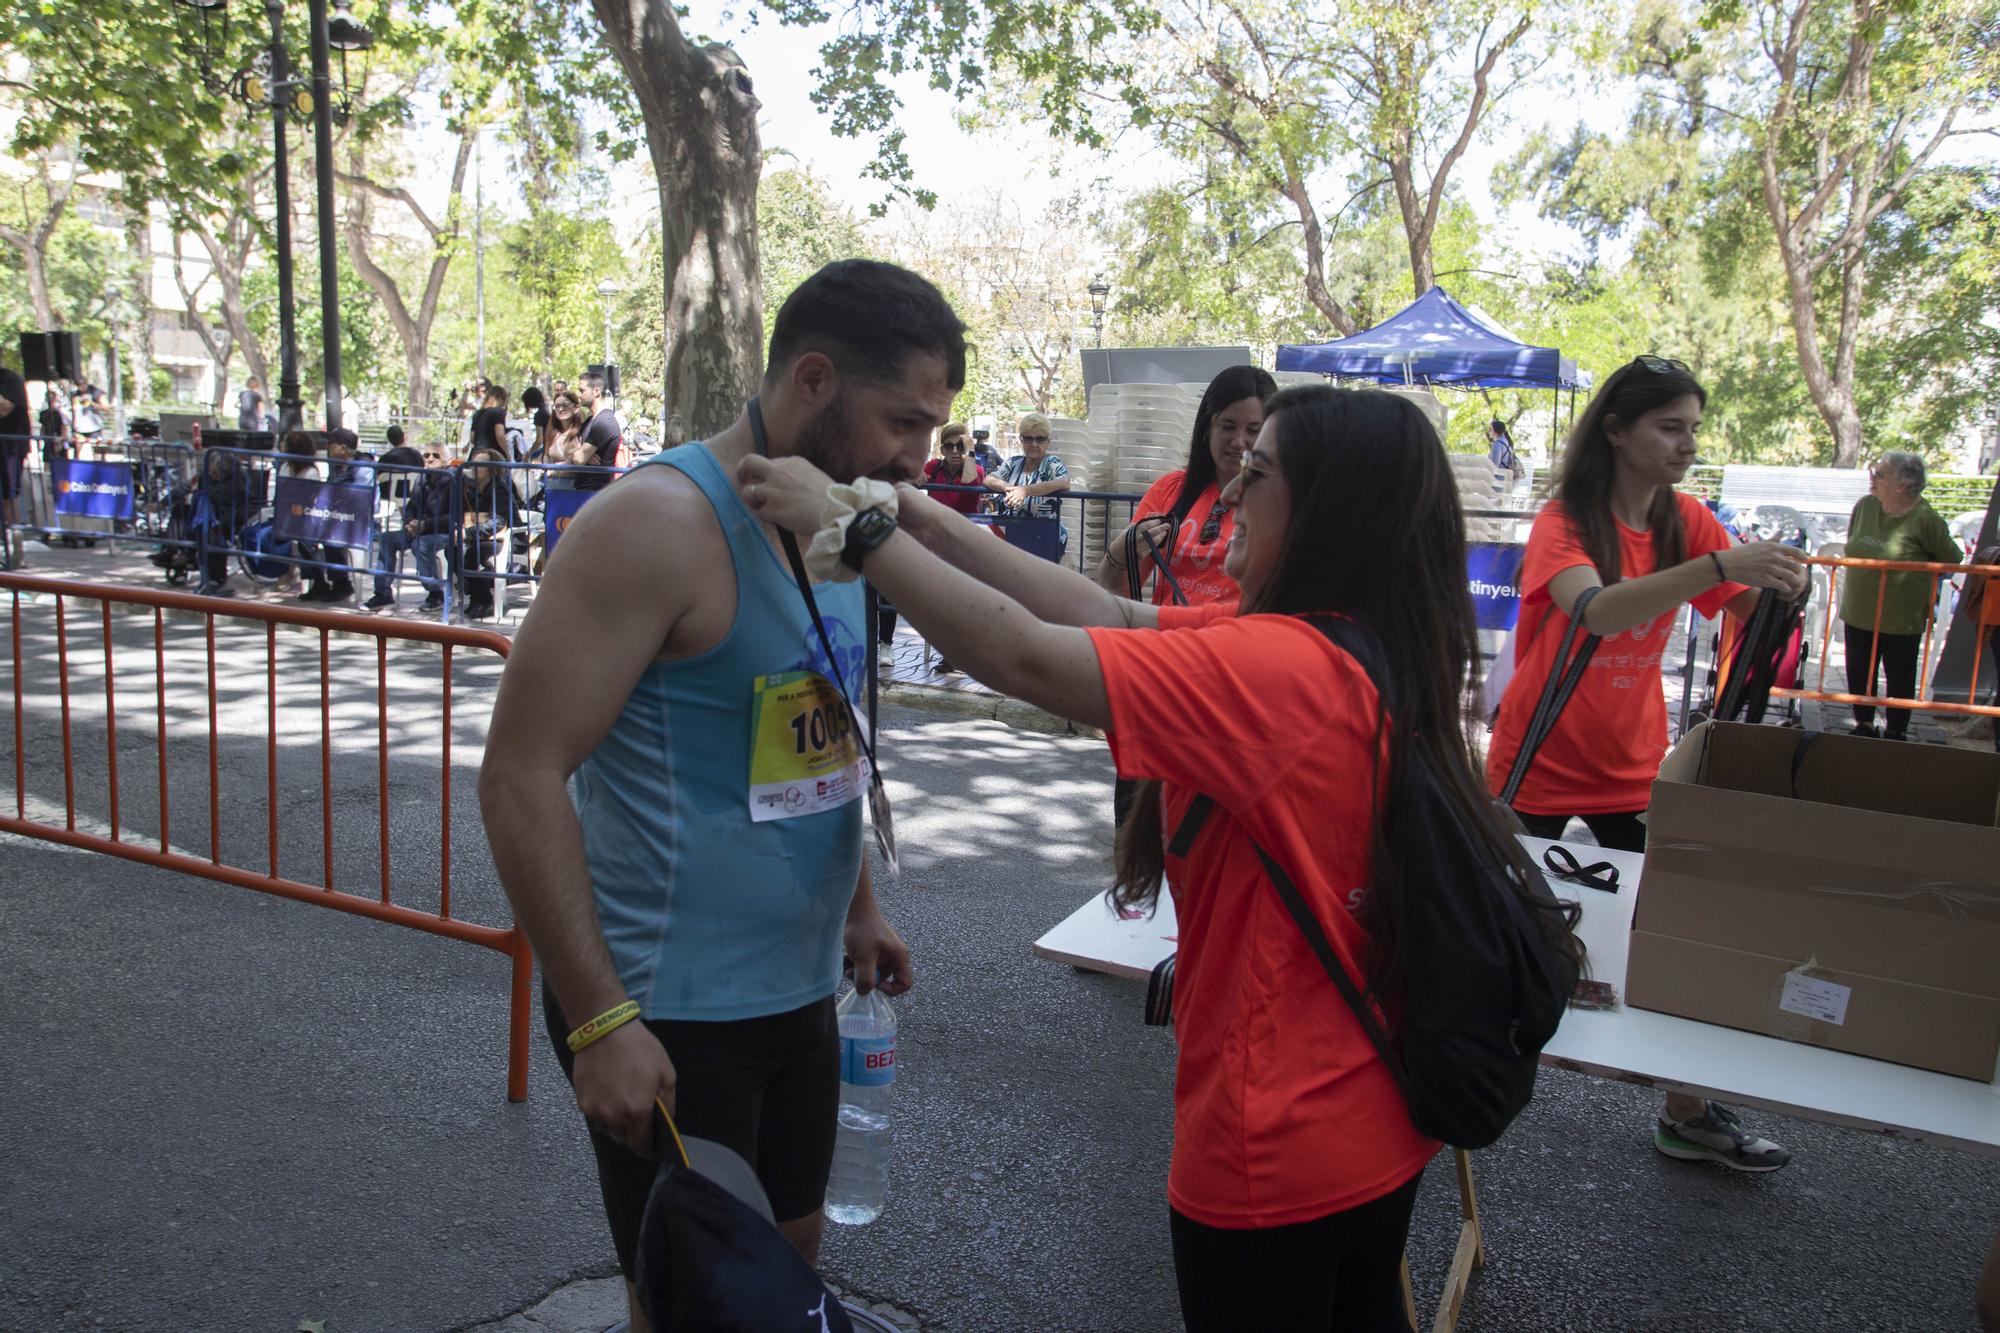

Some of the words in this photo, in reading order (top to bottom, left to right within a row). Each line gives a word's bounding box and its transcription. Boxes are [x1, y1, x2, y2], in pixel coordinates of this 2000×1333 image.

[70, 480, 91, 493] Caixa
[91, 483, 128, 497] Ontinyent
[304, 506, 324, 518] Caixa
[324, 508, 356, 523] Ontinyent
